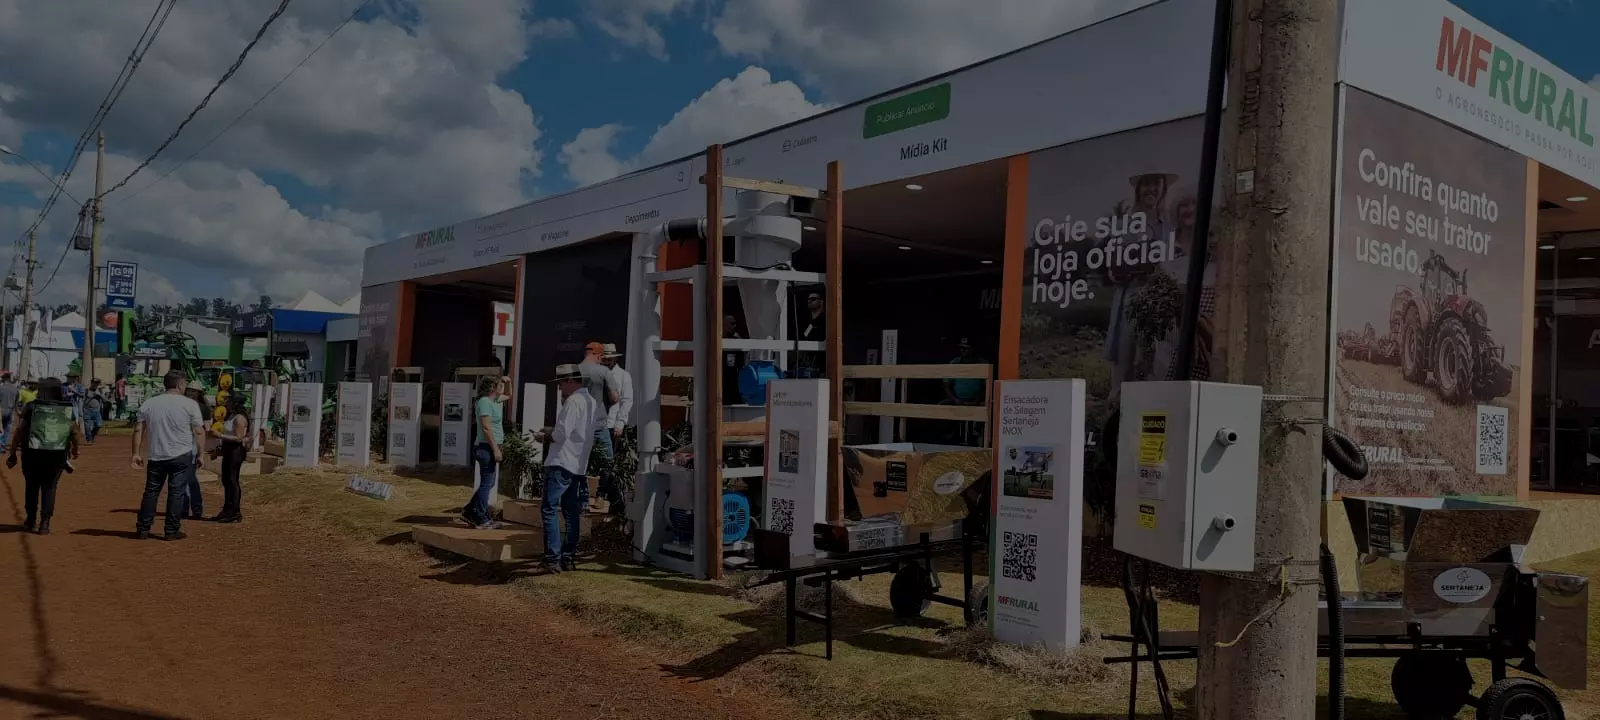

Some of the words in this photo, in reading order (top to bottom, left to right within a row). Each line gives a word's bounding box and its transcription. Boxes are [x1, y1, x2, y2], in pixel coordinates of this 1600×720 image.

[1436, 15, 1594, 149] MFRURAL
[1435, 86, 1443, 100] O
[876, 109, 904, 125] Publicar
[900, 141, 930, 161] Mídia
[932, 137, 949, 155] Kit
[1357, 147, 1433, 203] Confira
[1436, 182, 1500, 224] quanto
[1034, 212, 1089, 246] Crie
[1094, 210, 1148, 240] sua
[1356, 194, 1401, 231] vale
[1404, 210, 1440, 242] seu
[1443, 217, 1493, 256] trator
[1033, 244, 1080, 282] loja
[1086, 229, 1176, 270] oficial
[1032, 272, 1096, 309] hoje.
[1003, 395, 1048, 405] Ensacadora
[1350, 385, 1379, 399] Consulte
[1003, 405, 1013, 415] de
[1014, 405, 1046, 417] Silagem
[1002, 416, 1039, 428] Sertaneja
[1002, 427, 1023, 436] INOX
[1441, 584, 1485, 592] SERTANEJA
[998, 595, 1040, 612] MFRURAL
